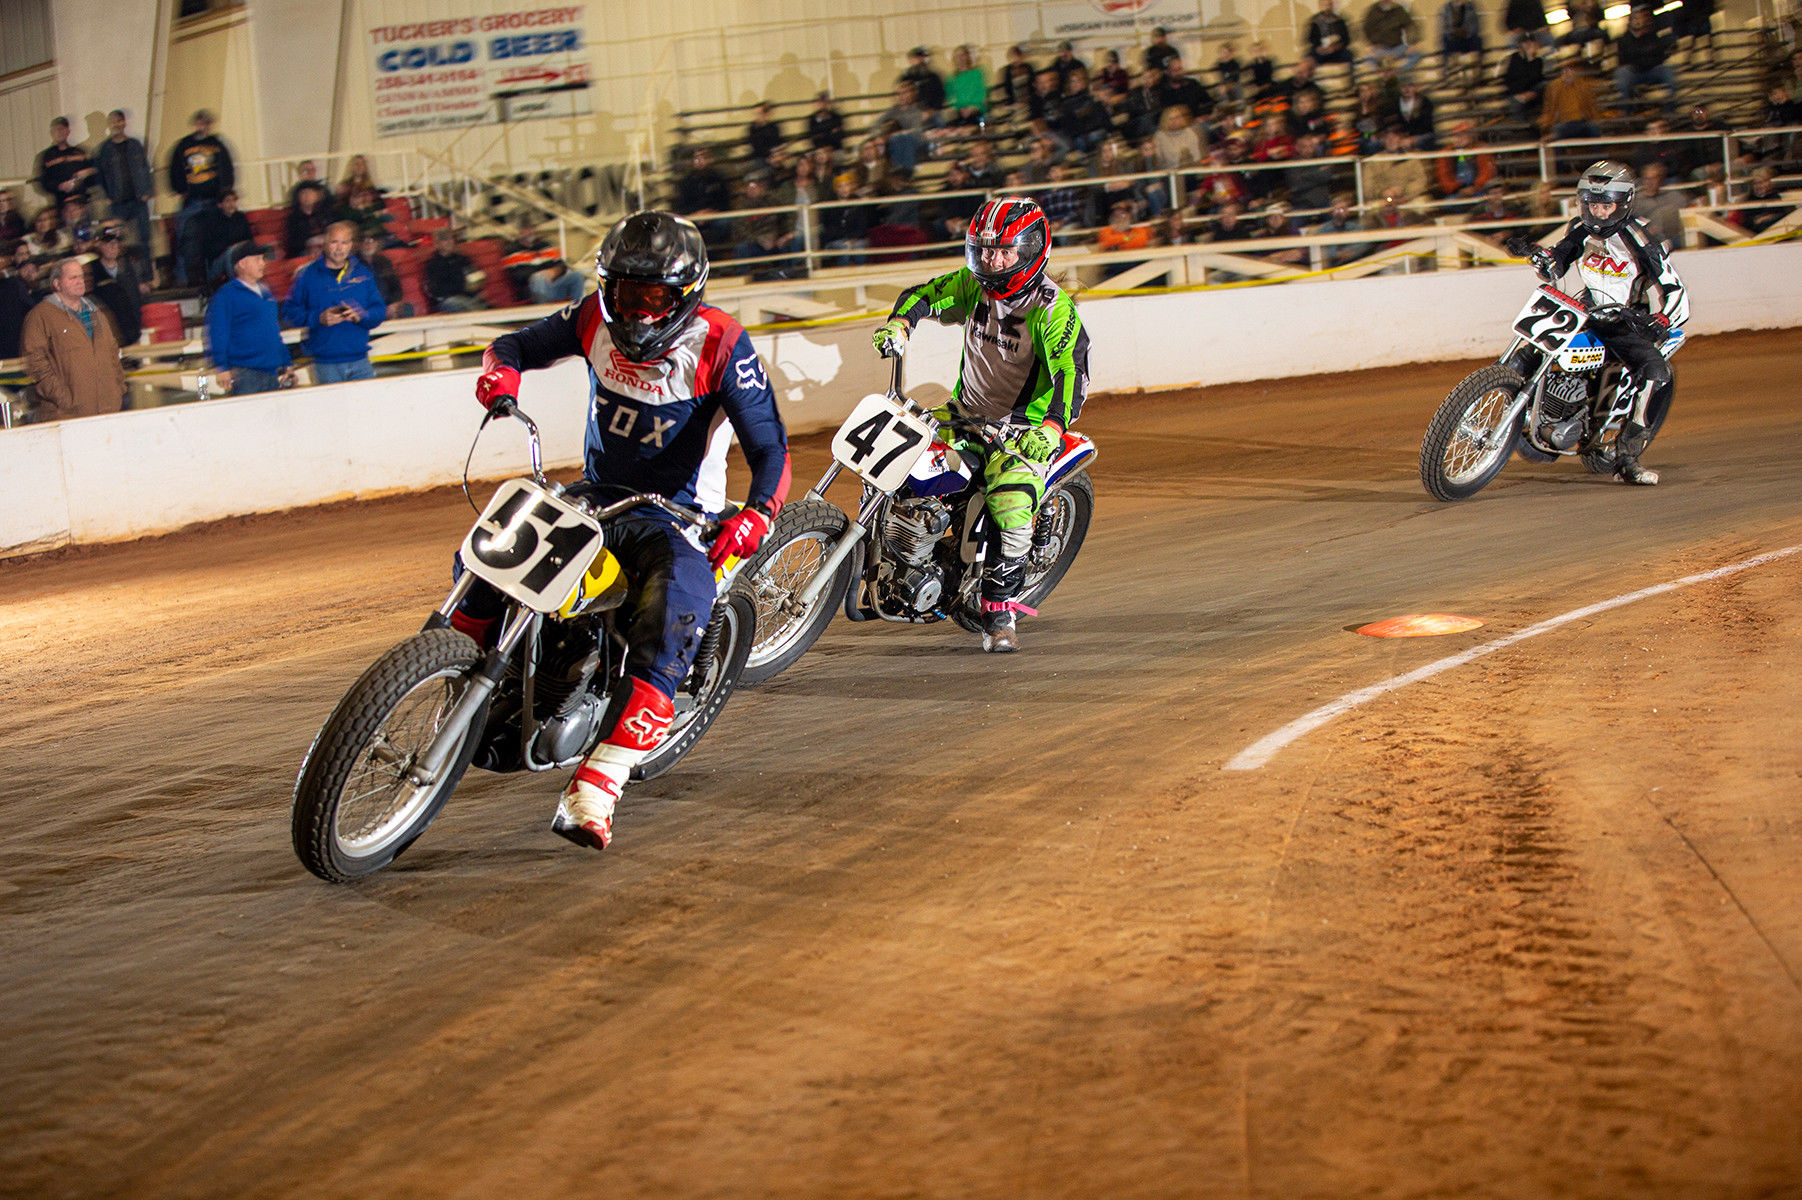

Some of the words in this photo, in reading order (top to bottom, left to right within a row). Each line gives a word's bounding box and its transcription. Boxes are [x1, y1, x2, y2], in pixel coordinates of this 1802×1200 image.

[369, 18, 474, 45] TUCKER'S
[479, 6, 583, 33] GROCERY
[376, 41, 476, 72] COLD
[487, 29, 583, 61] BEER
[1584, 253, 1629, 273] GN
[1514, 295, 1578, 351] 72
[603, 367, 664, 397] HONDA
[591, 394, 677, 448] FOX
[845, 410, 923, 479] 47
[471, 487, 598, 595] 51
[735, 518, 754, 546] FOX
